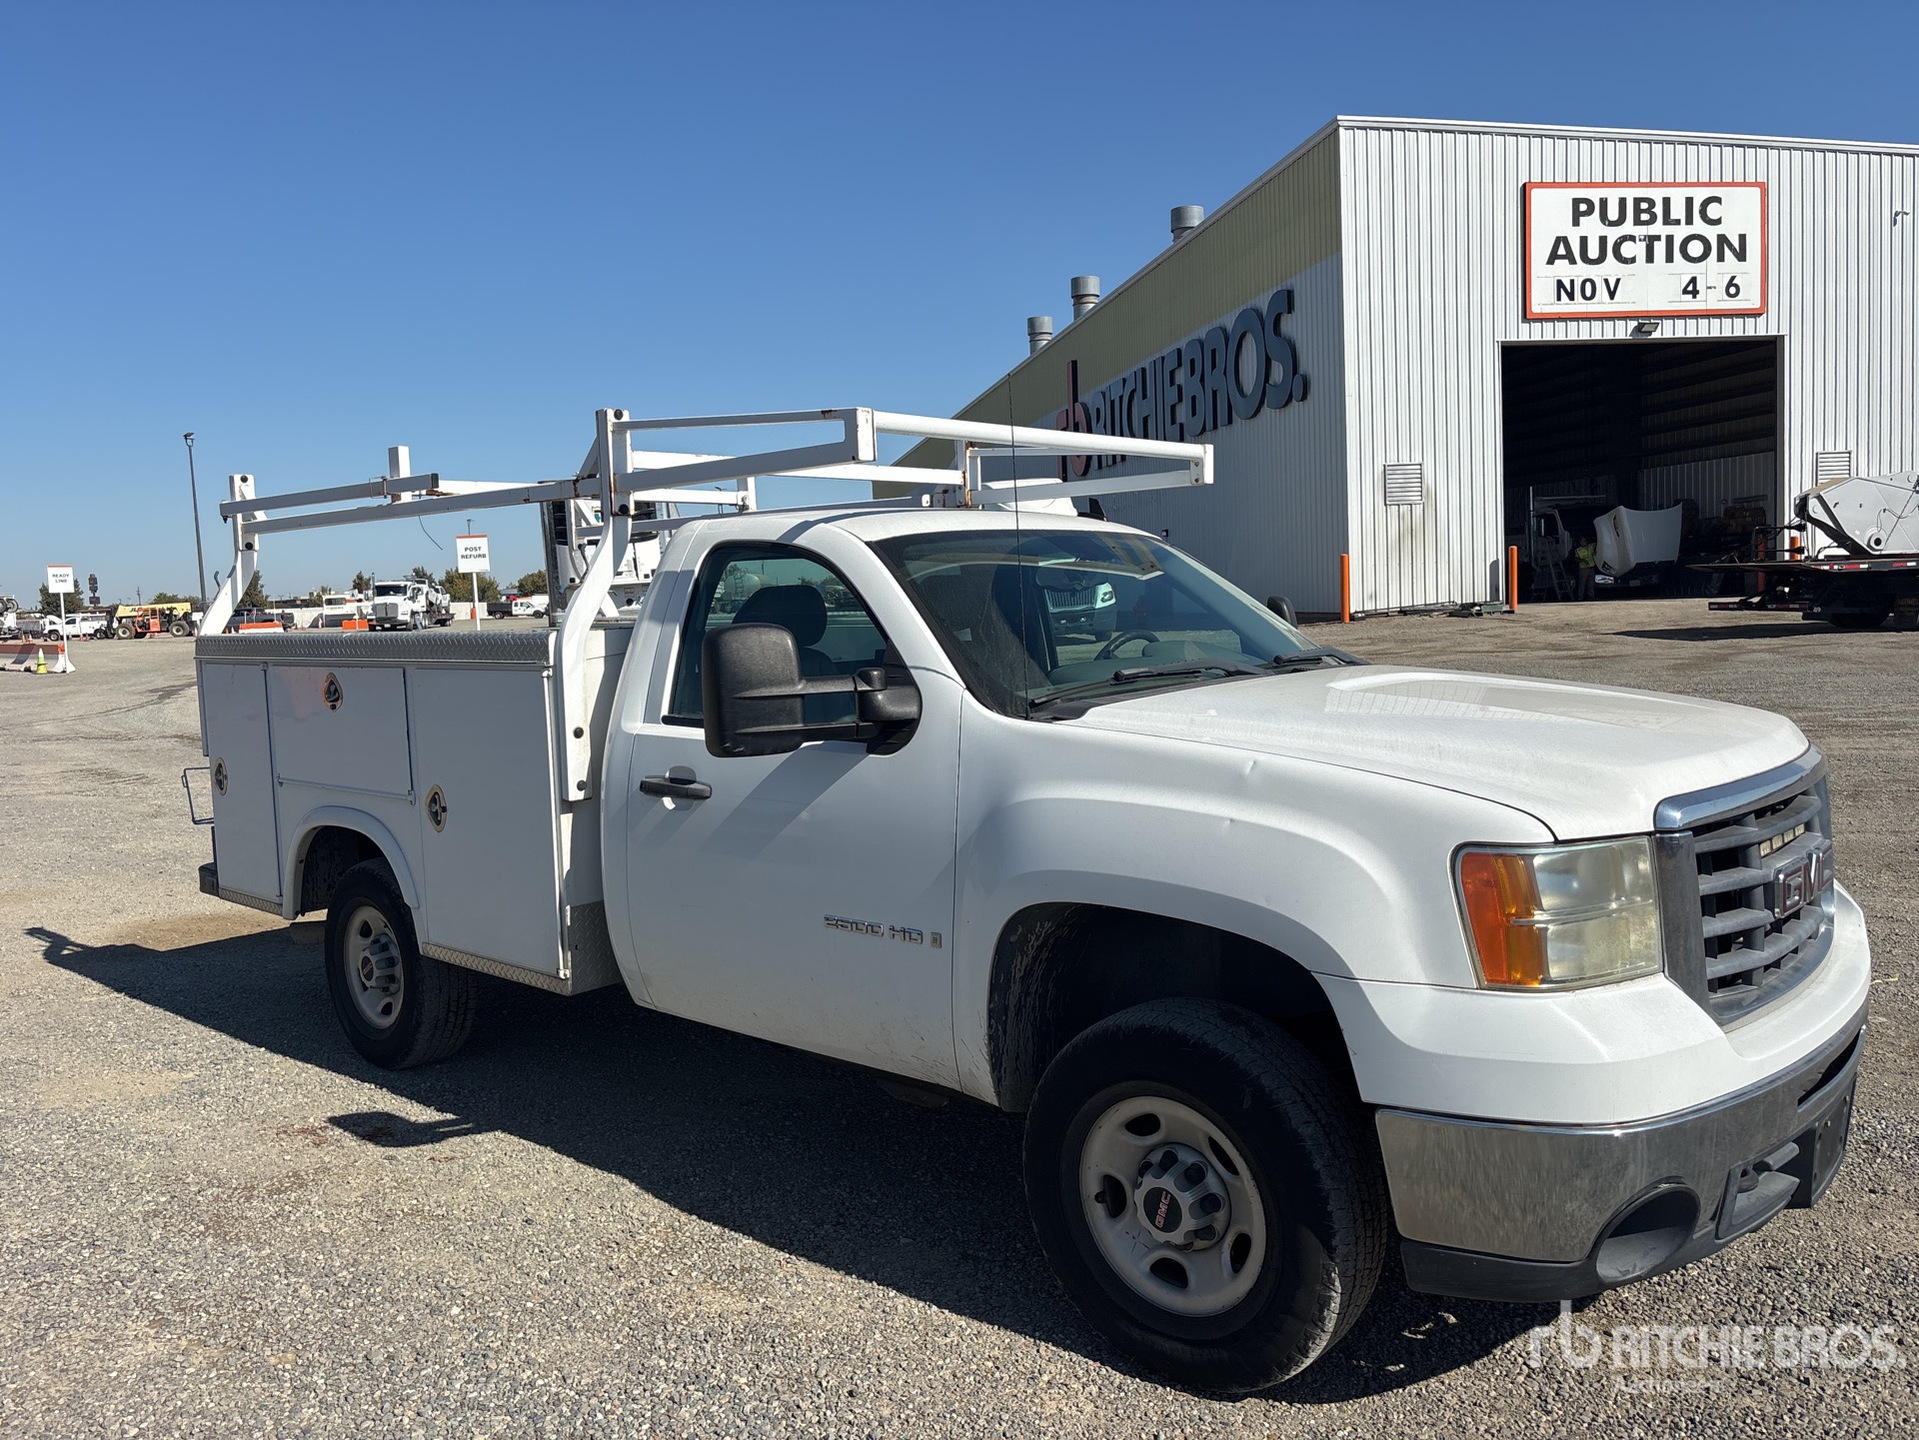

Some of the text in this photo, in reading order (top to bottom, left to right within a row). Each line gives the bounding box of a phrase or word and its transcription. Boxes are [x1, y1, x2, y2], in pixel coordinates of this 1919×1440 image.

[1571, 195, 1723, 228] PUBLIC
[1545, 233, 1747, 266] AUCTION
[823, 914, 924, 945] 2500 HD
[1155, 1190, 1171, 1228] GMC
